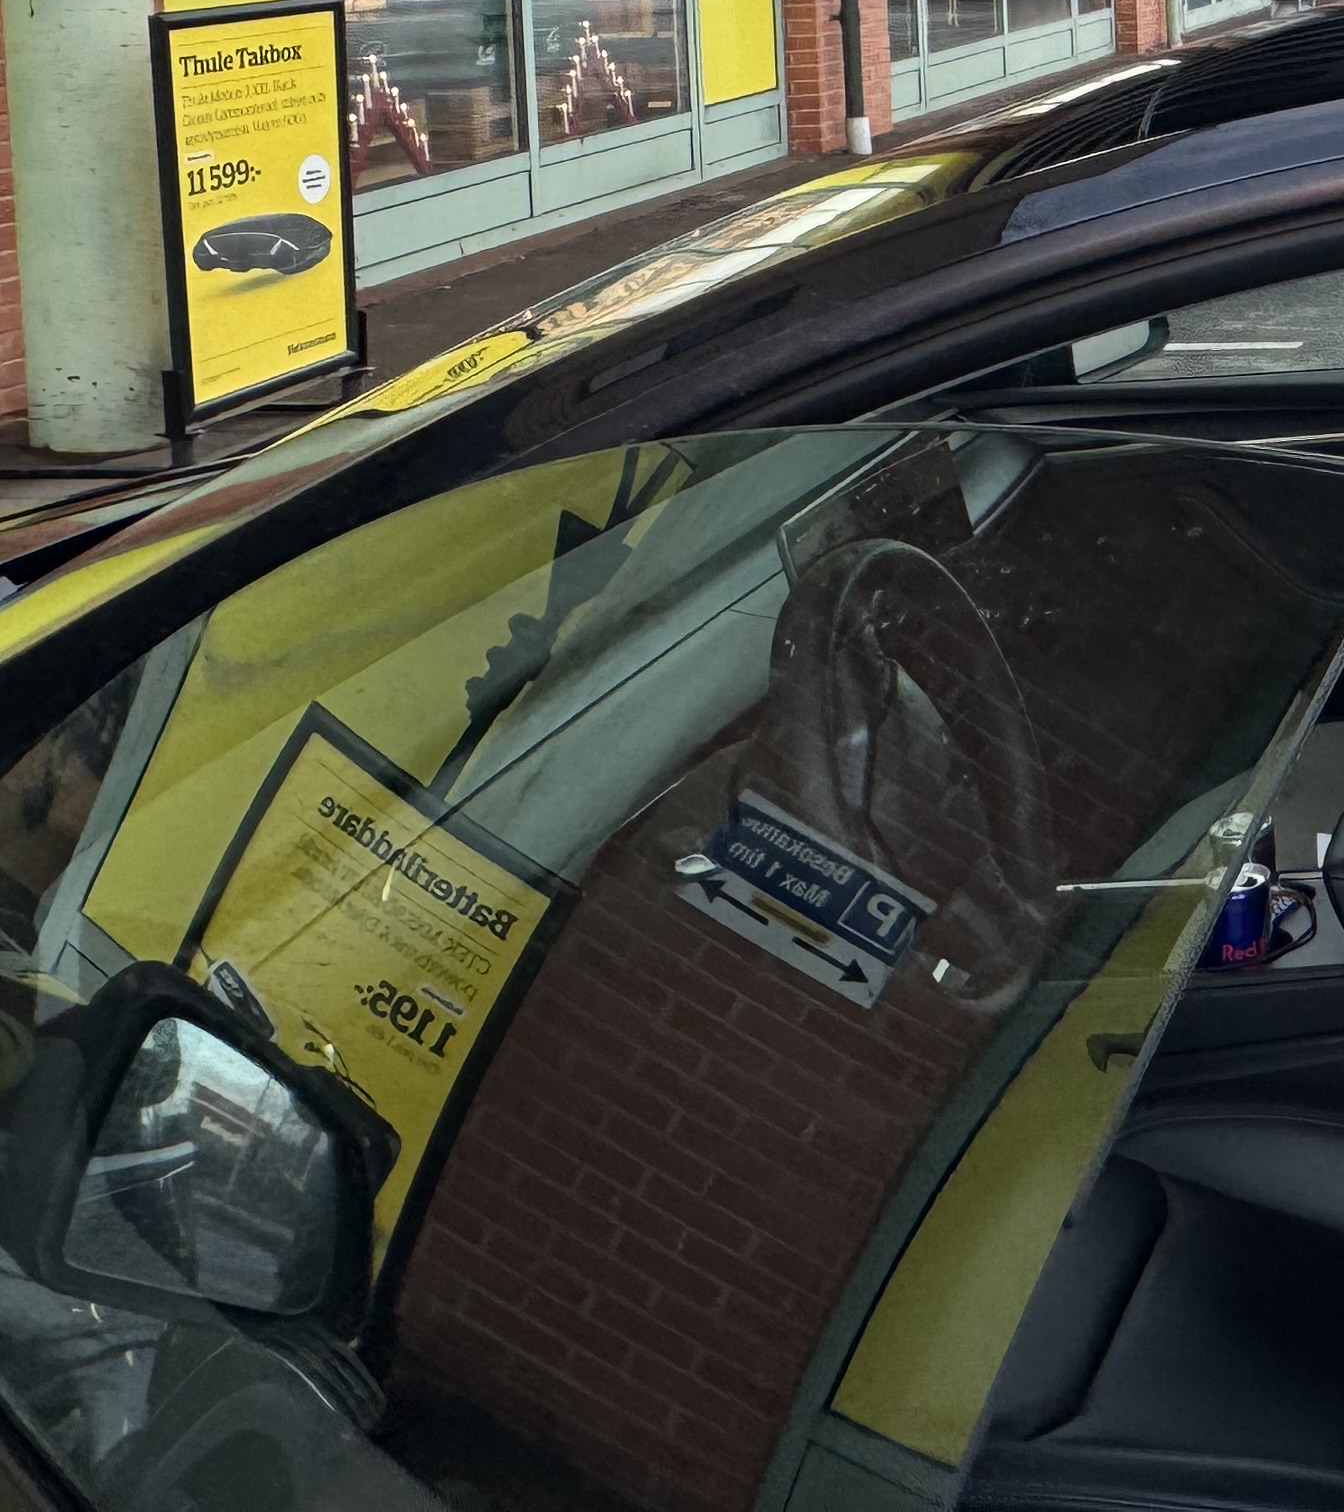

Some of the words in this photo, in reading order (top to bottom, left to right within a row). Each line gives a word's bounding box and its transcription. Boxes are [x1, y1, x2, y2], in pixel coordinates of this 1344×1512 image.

[179, 51, 234, 78] Thule
[236, 44, 302, 70] Takbox
[1222, 941, 1258, 961] Red
